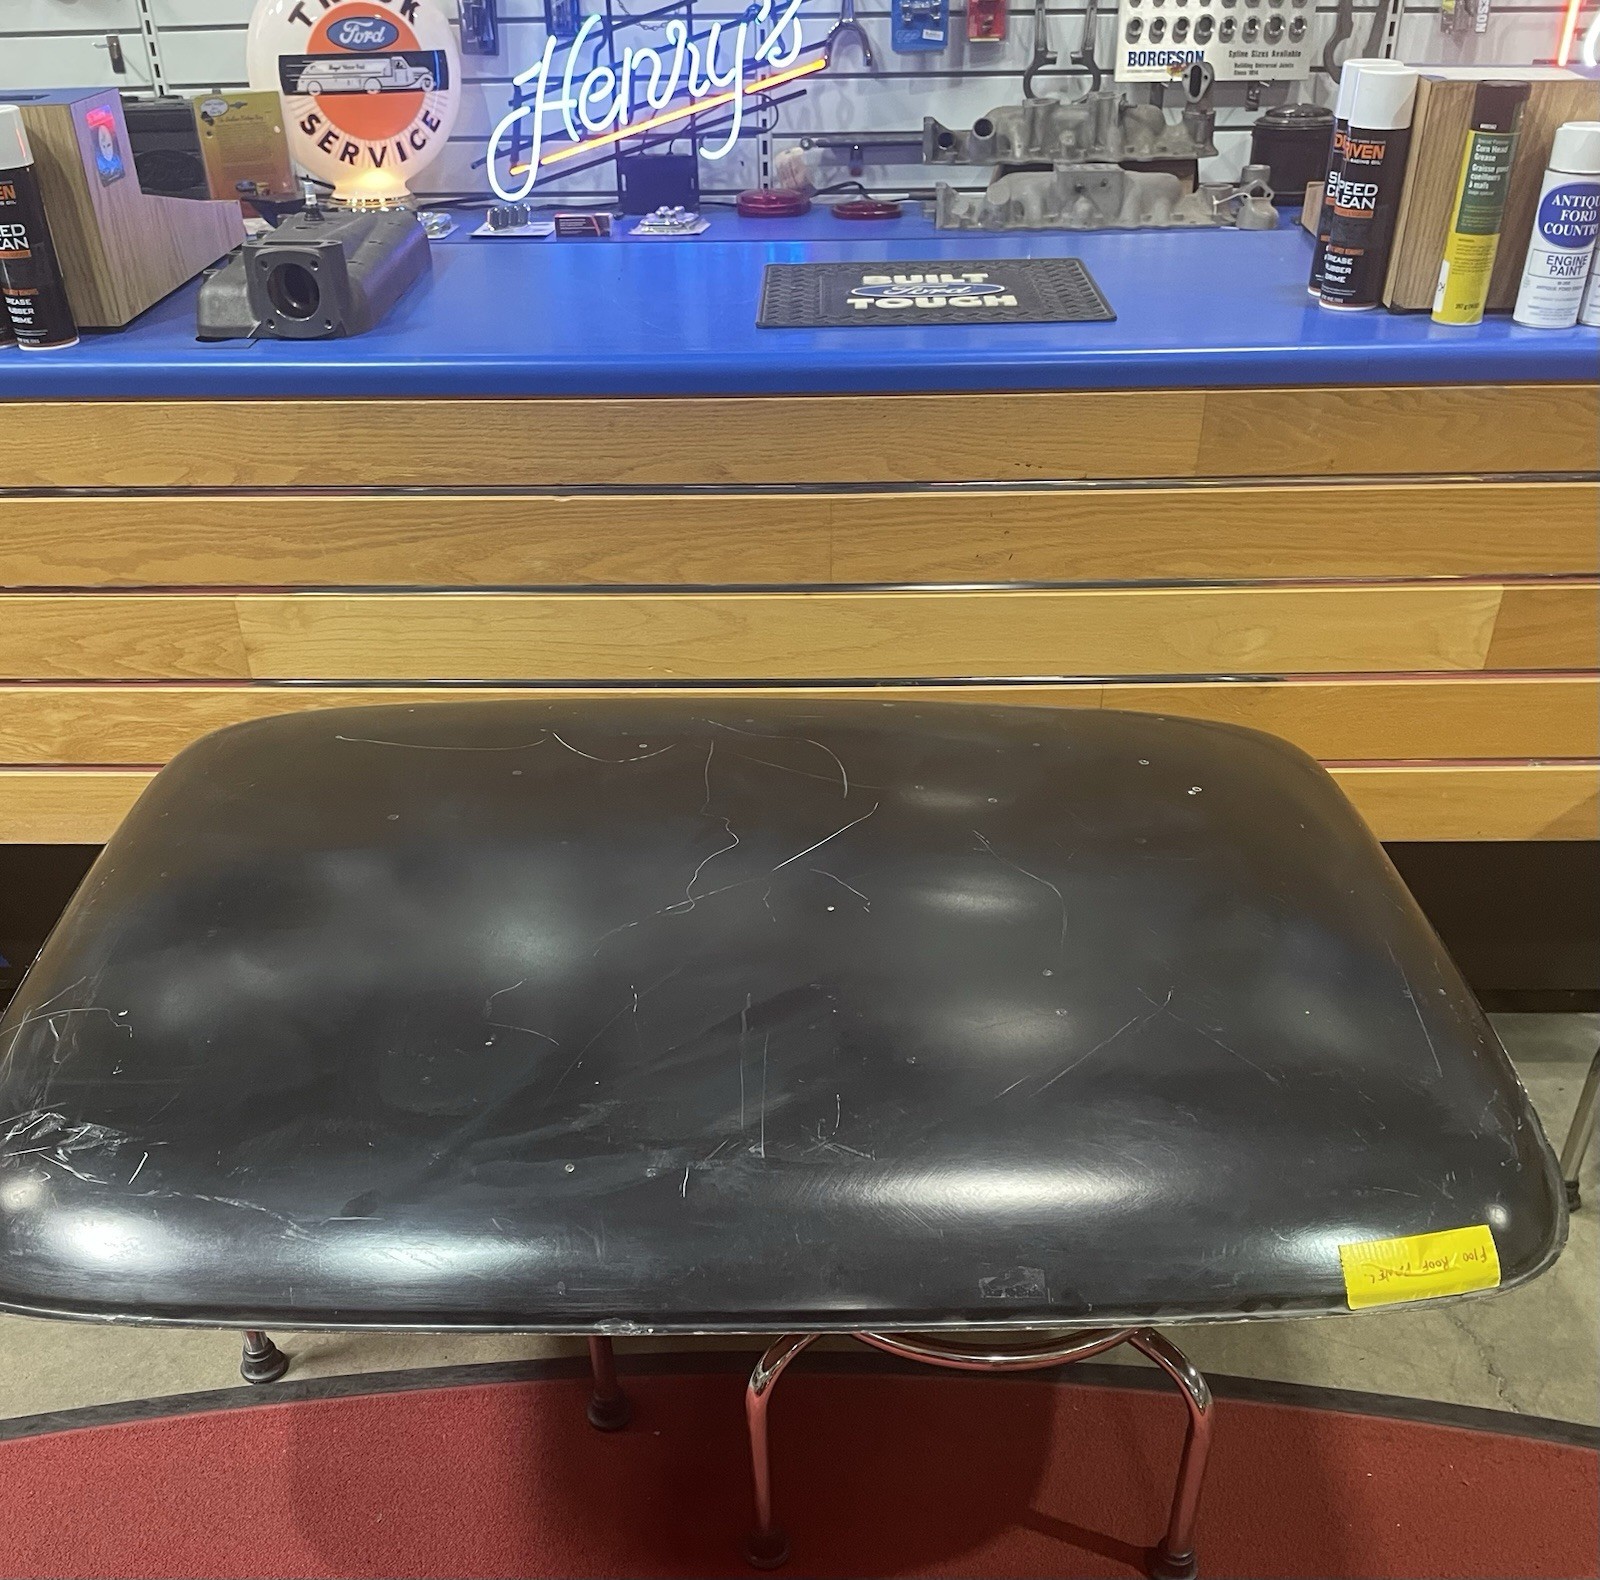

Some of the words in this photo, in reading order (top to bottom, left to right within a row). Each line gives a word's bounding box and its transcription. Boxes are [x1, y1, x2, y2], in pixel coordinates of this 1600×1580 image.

[339, 19, 386, 44] Ford
[1128, 50, 1204, 67] BORGESON
[487, 0, 803, 202] Henry's
[300, 110, 441, 168] SERVICE
[1560, 209, 1597, 222] FORD
[1546, 254, 1588, 266] ENGINE
[1549, 265, 1583, 276] PAINT
[862, 273, 989, 285] BUILT
[883, 284, 972, 296] Ford
[847, 295, 1018, 309] TOUGH
[1463, 1246, 1487, 1263] F100
[1422, 1256, 1450, 1272] ROOF
